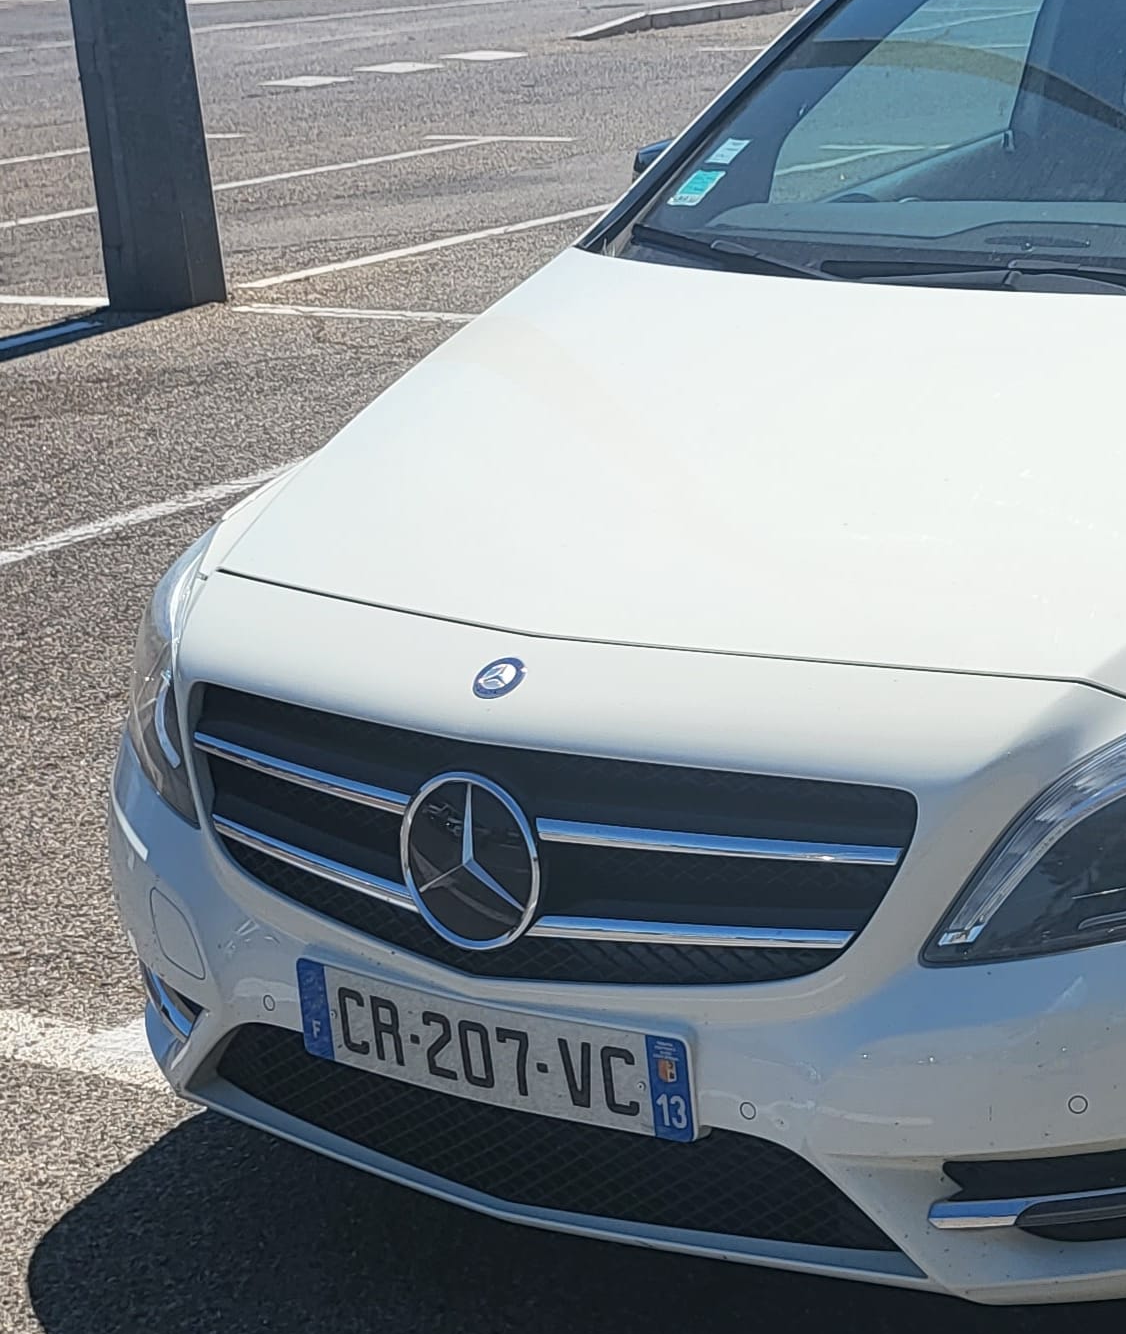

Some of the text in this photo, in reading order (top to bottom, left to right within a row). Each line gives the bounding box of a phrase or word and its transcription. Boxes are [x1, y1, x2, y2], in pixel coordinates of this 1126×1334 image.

[311, 1019, 321, 1040] F
[337, 986, 641, 1116] CR-207-VC
[656, 1093, 688, 1129] 13
